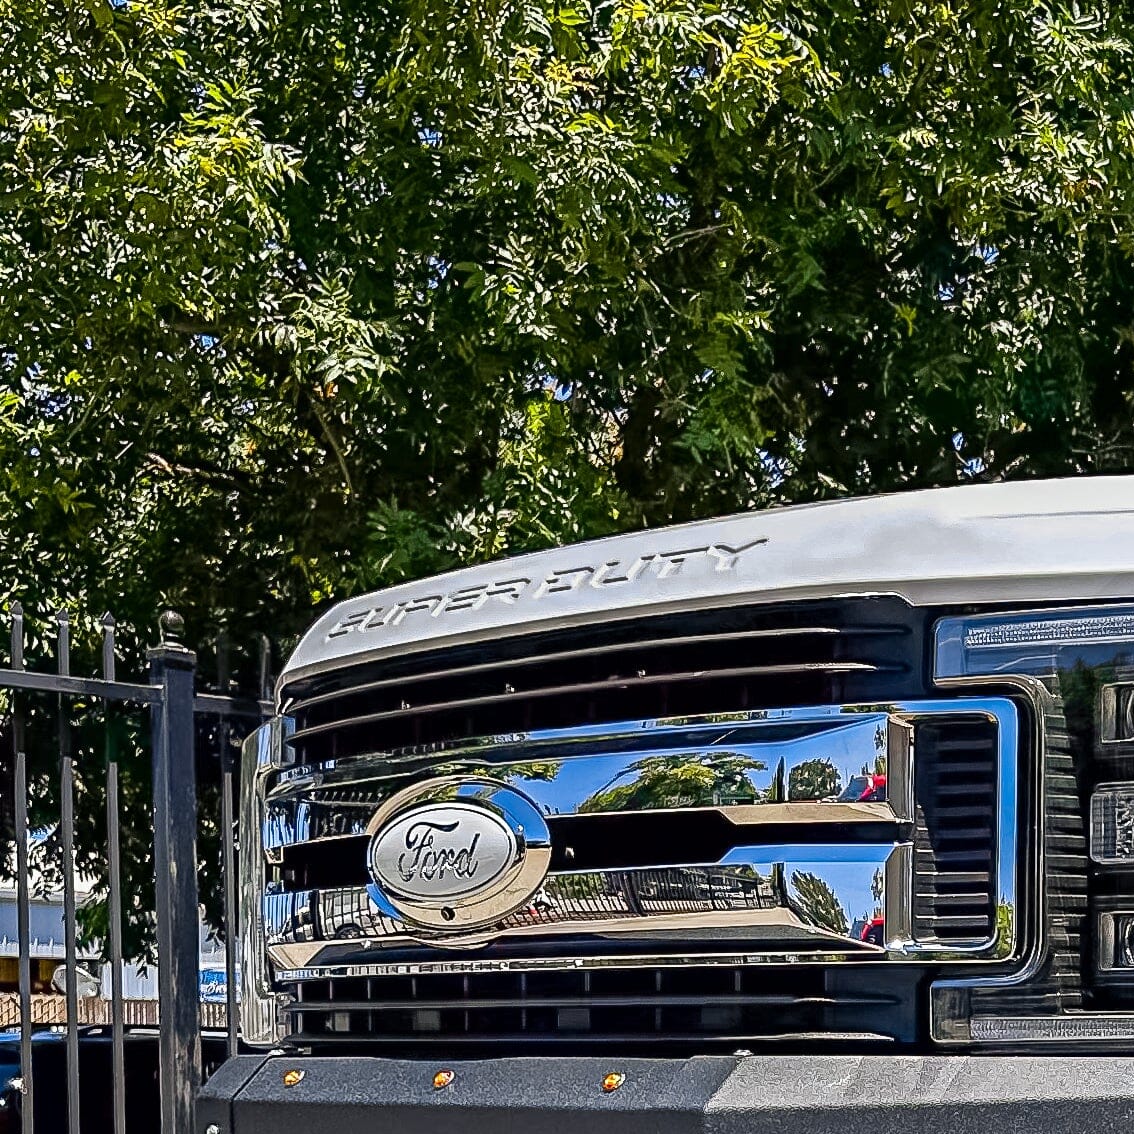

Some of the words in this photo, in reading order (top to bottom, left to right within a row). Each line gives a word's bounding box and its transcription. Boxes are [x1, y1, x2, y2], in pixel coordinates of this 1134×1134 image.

[325, 577, 531, 642] SUPER
[533, 536, 770, 600] DUTY
[397, 820, 481, 883] Ford
